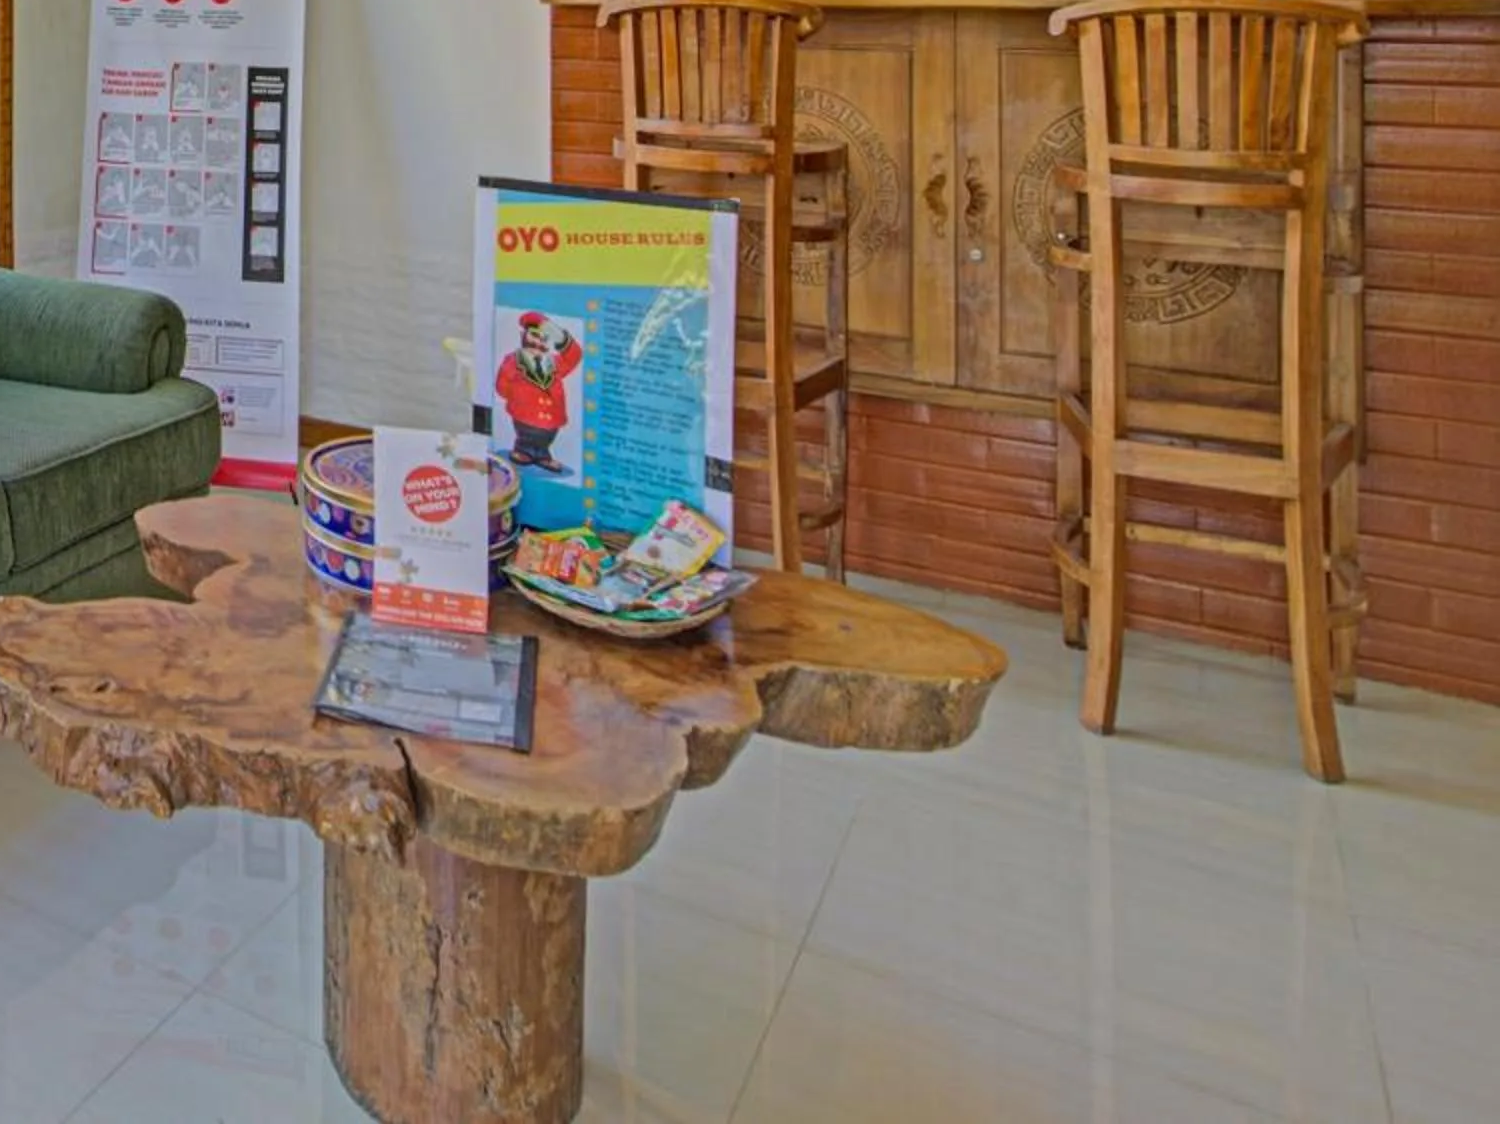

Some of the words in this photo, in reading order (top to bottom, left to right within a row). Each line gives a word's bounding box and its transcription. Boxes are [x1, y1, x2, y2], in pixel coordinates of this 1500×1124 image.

[497, 227, 560, 253] OYO
[566, 232, 634, 245] HOUSE
[425, 486, 460, 501] YOUR
